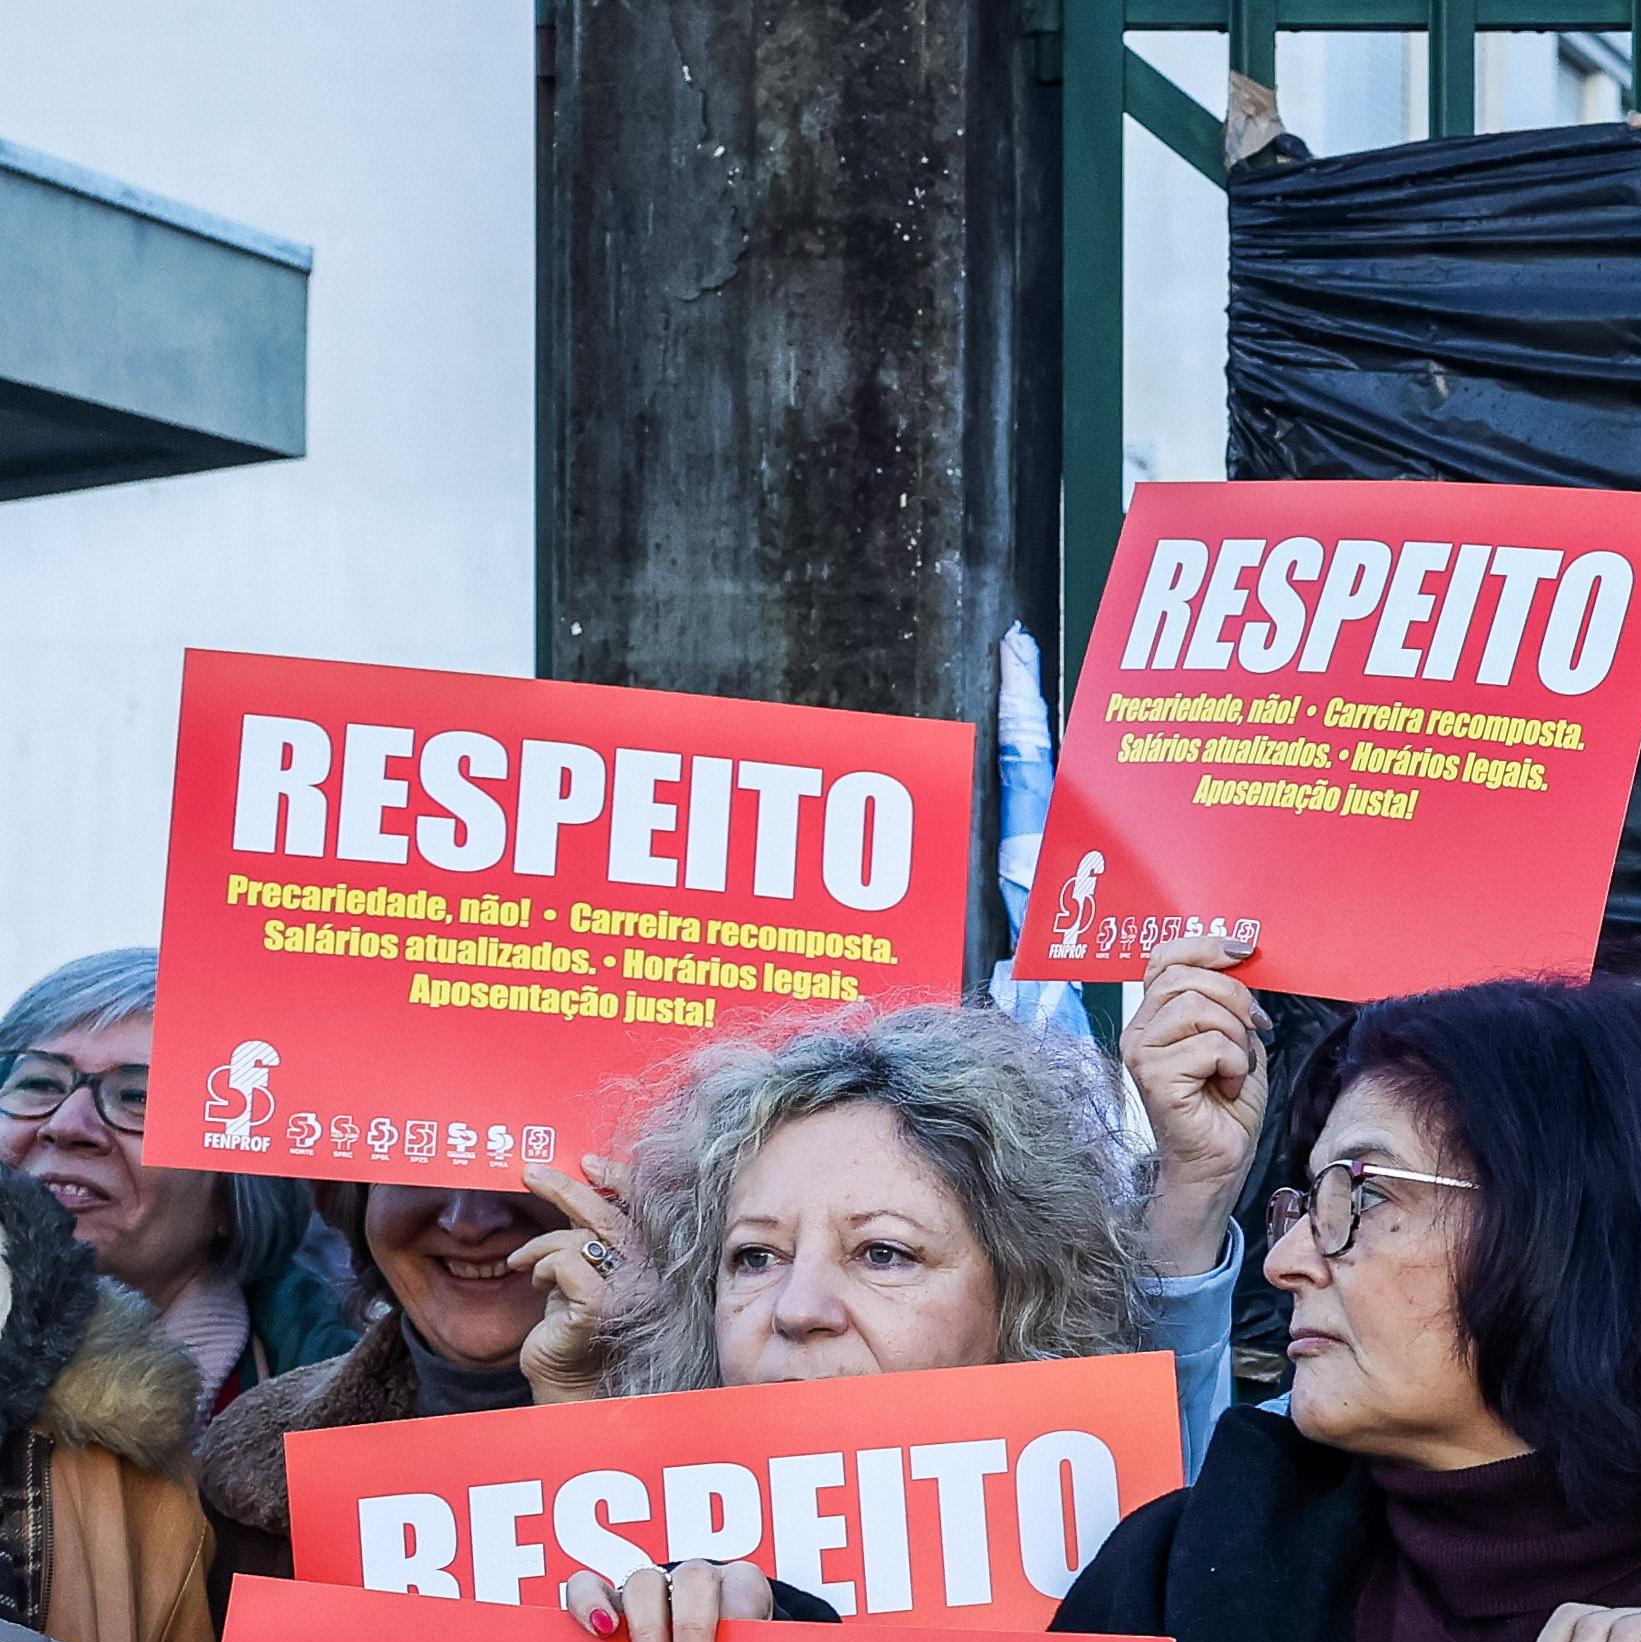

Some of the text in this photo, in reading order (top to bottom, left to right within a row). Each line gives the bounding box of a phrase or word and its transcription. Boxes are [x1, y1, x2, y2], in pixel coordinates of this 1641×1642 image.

[1119, 536, 1635, 696] RESPEITO
[1104, 693, 1585, 751] Precariedade, não! Carreira recomposta.
[1117, 733, 1549, 791] Salários atualizados. Horários legais.
[231, 713, 915, 911] RESPEITO
[1192, 775, 1420, 820] Aposentação justa!
[227, 874, 899, 965] Precariedade, não! Carreira recomposta.
[264, 919, 865, 1002] Salários atualizados. Horários legais.
[1048, 943, 1088, 960] FENPROF
[409, 972, 717, 1028] Aposentação justa!
[203, 1132, 271, 1153] FENPROF
